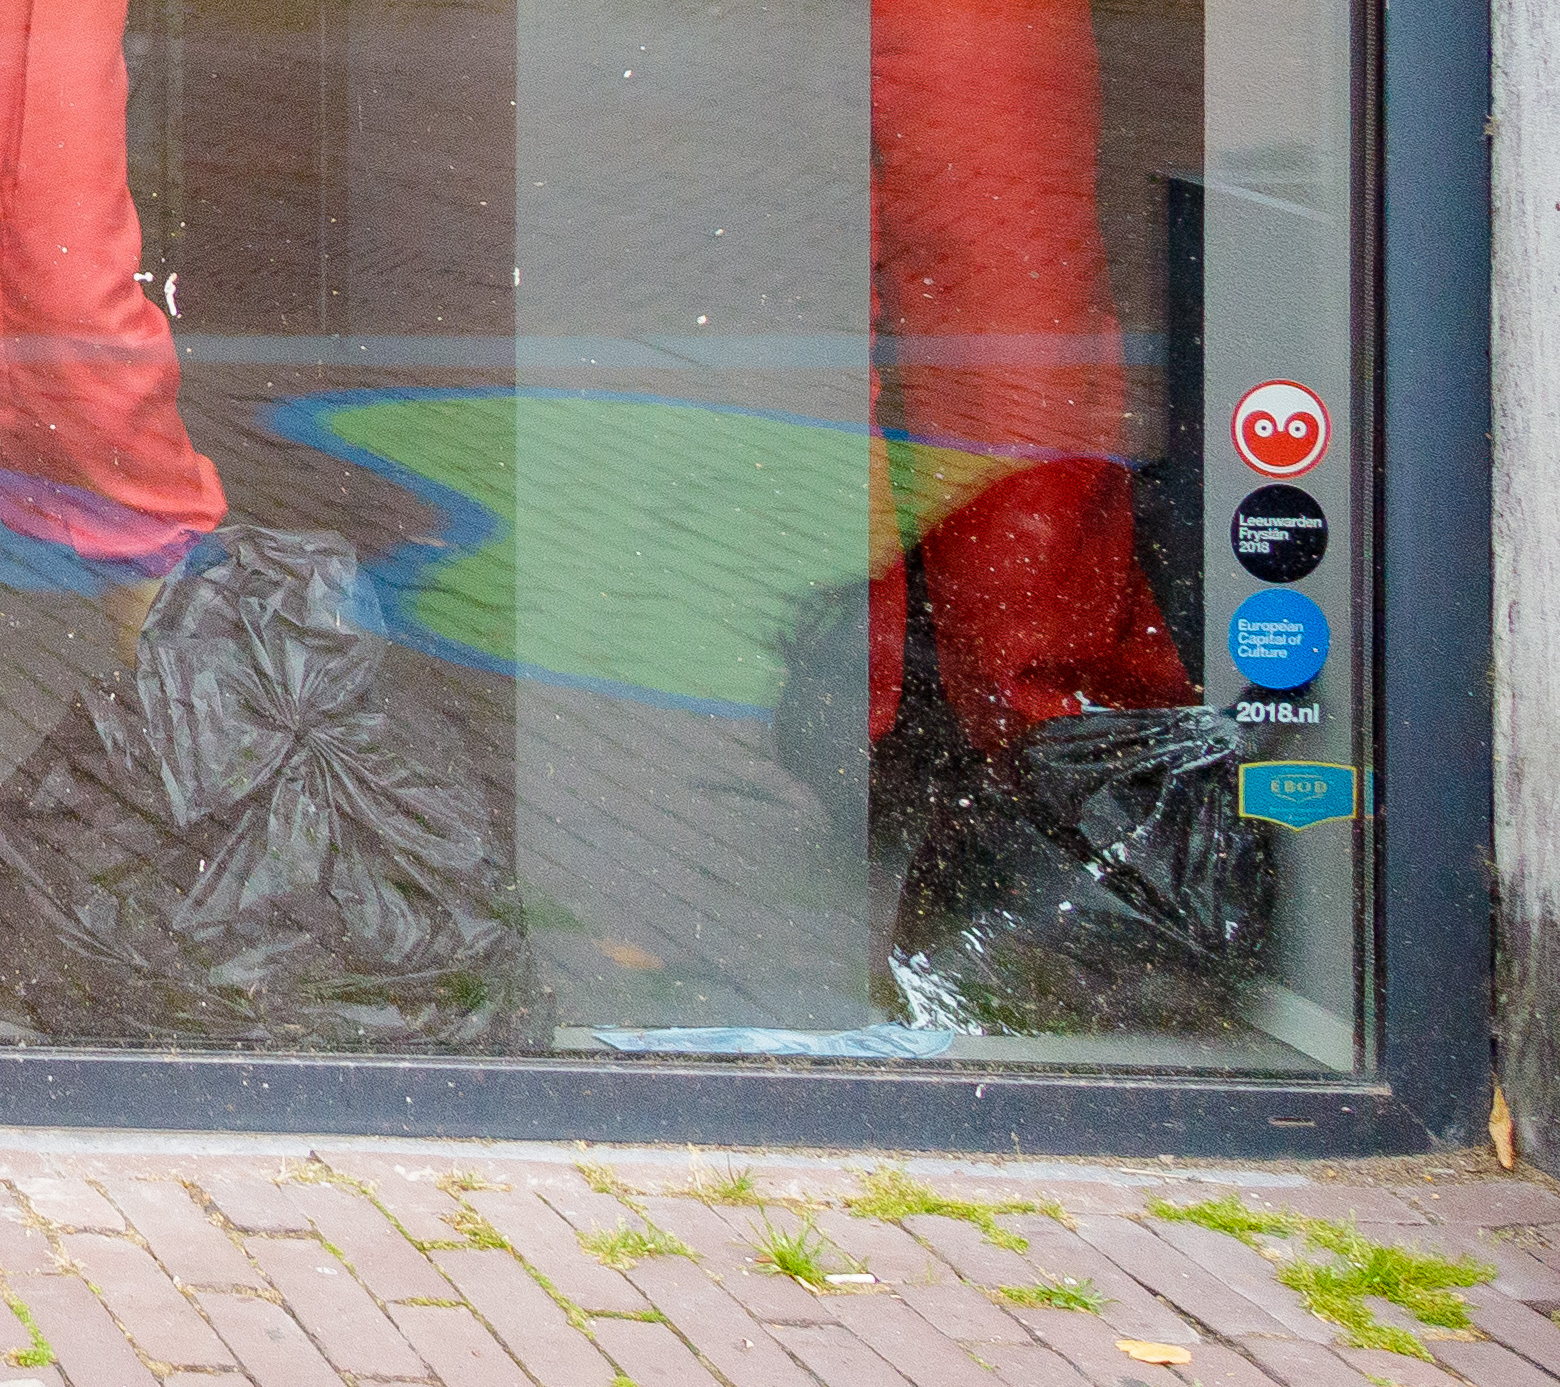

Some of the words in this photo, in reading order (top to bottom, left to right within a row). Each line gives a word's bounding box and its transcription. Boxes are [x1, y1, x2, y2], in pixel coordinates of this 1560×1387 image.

[1238, 513, 1323, 528] Leeuwarden
[1238, 541, 1270, 554] 2018
[1237, 619, 1304, 634] European
[1237, 632, 1287, 647] Capital
[1287, 633, 1303, 646] of
[1237, 645, 1288, 659] Culture
[1235, 701, 1320, 724] 2018.nl
